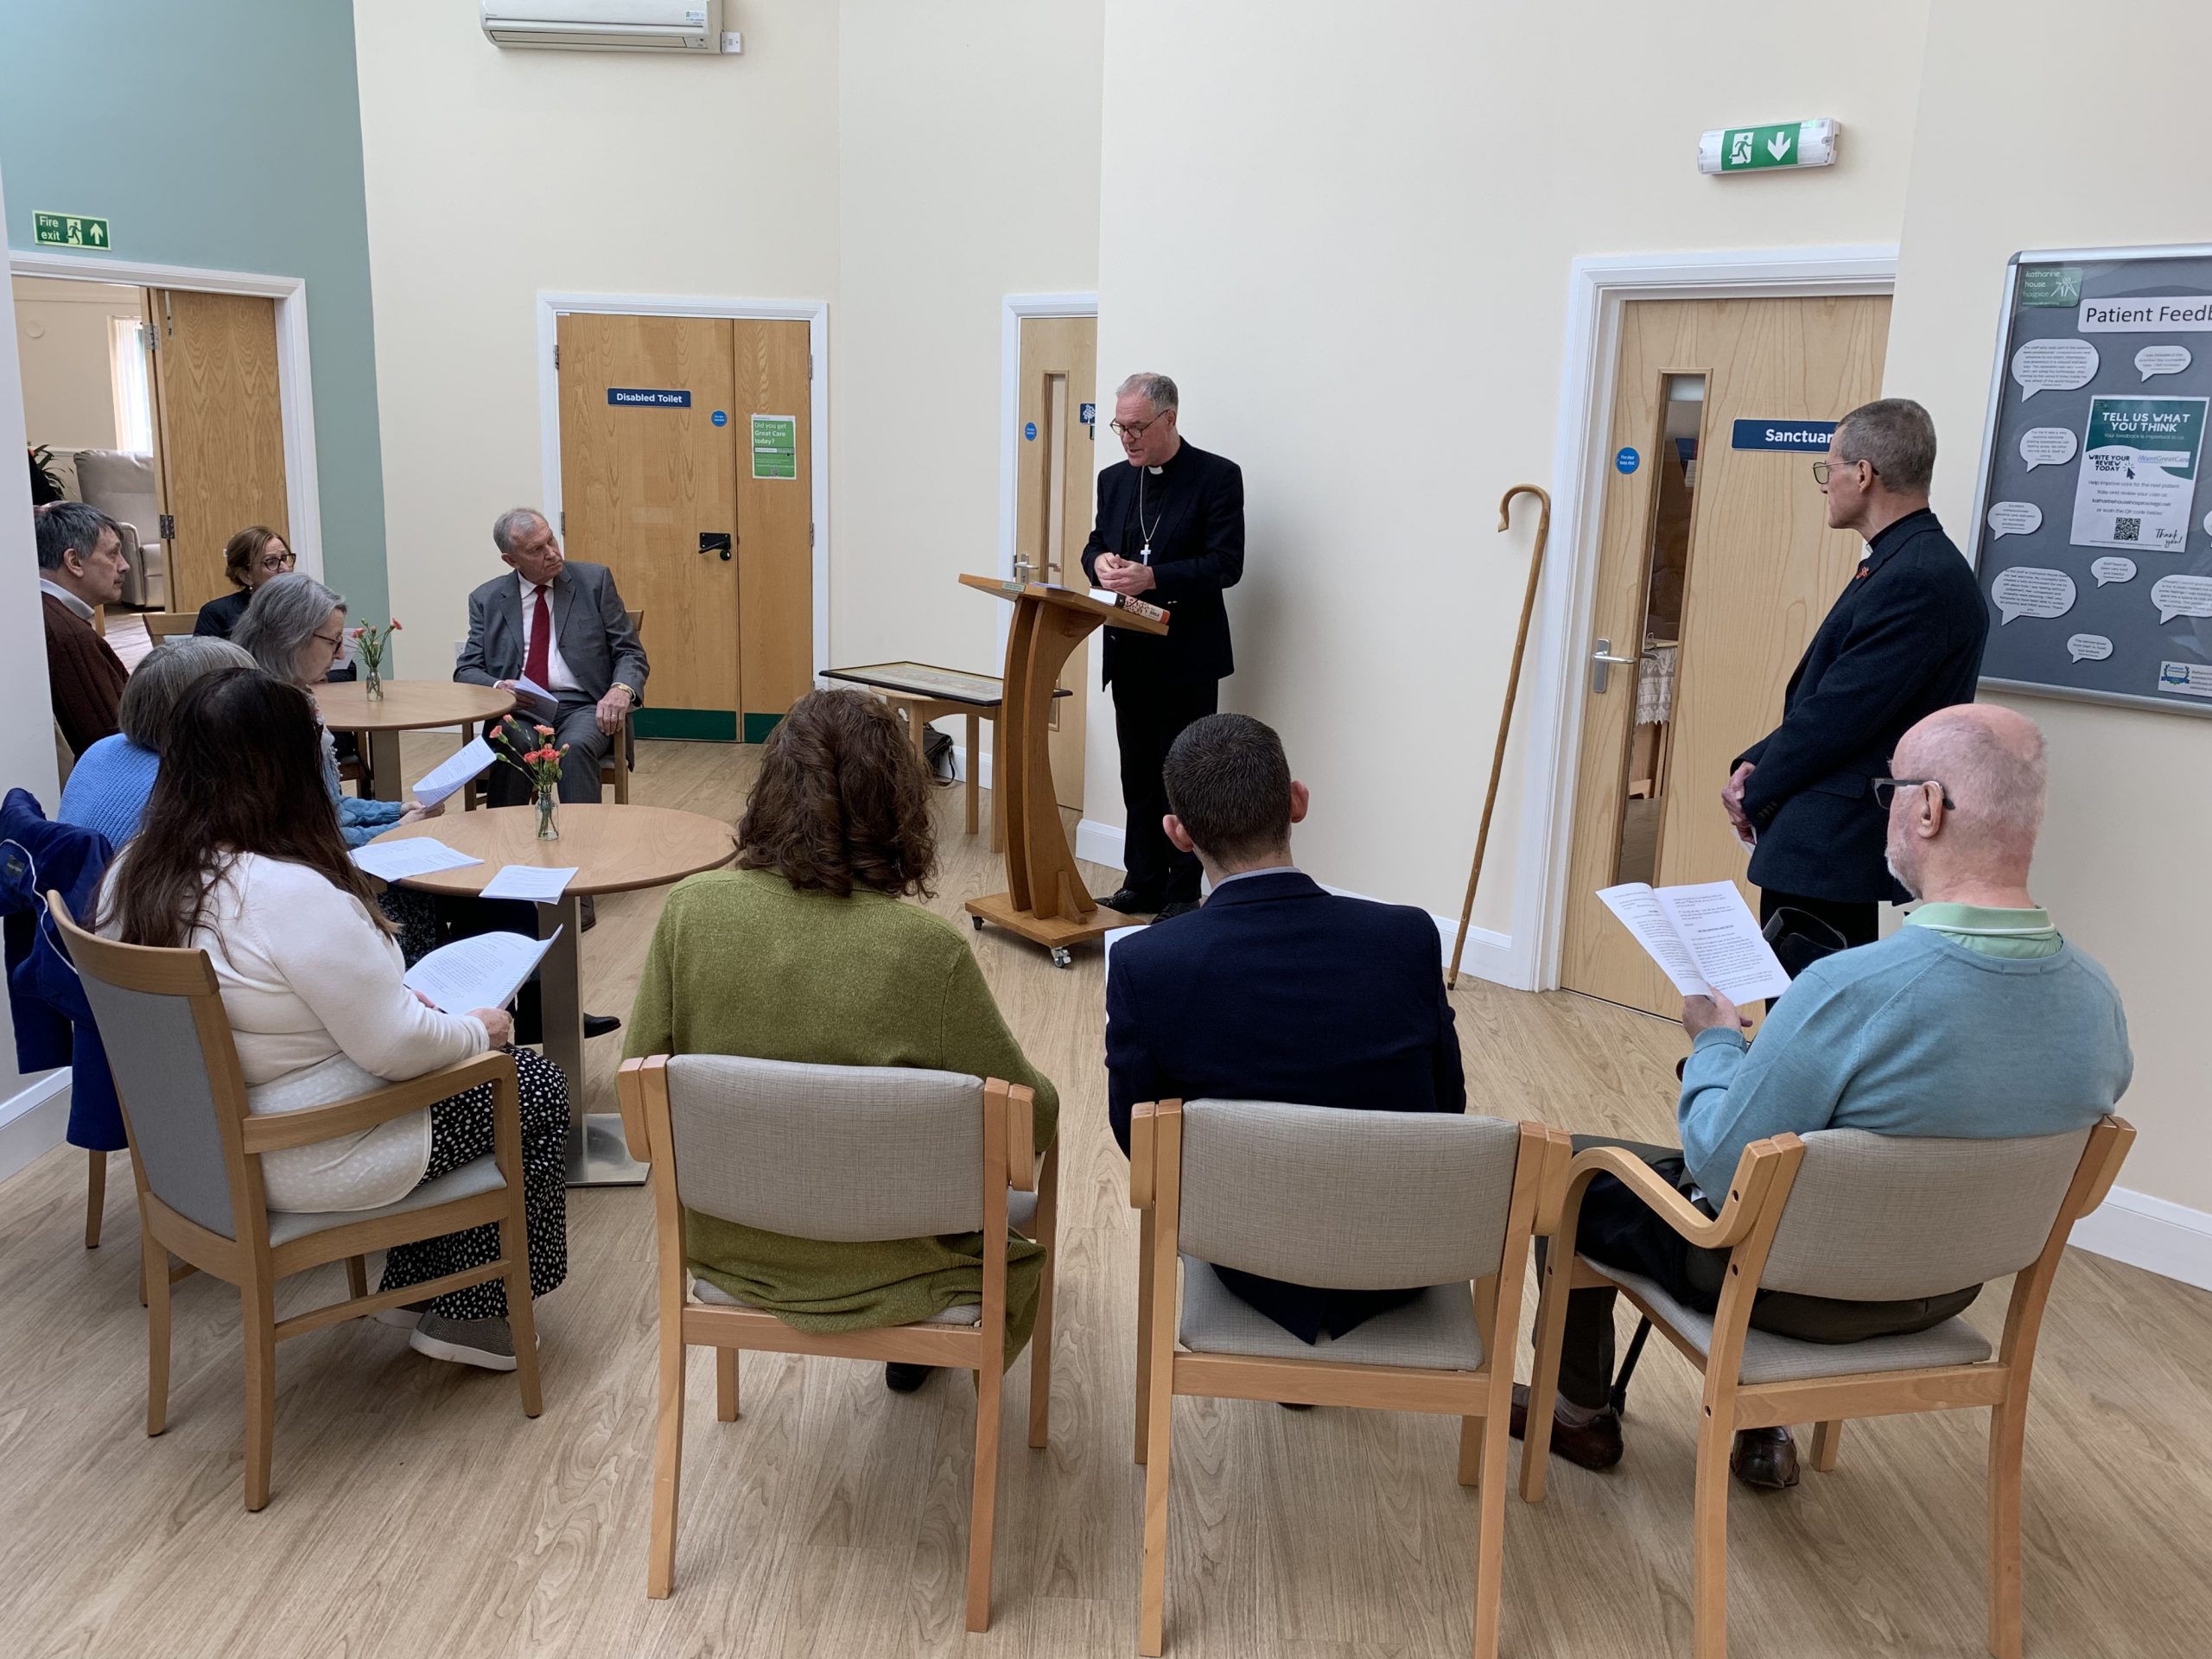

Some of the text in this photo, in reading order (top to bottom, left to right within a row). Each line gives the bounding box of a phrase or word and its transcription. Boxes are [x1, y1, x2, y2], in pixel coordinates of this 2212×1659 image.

[39, 215, 59, 227] Fire
[41, 230, 60, 240] exit
[2086, 307, 2153, 322] Patient
[616, 393, 683, 403] Disabled Toilet
[2101, 412, 2191, 423] TELL US WHAT
[2111, 422, 2178, 433] YOU THINK
[1765, 429, 1834, 443] Sanctuar
[2155, 528, 2178, 539] Thank
[2164, 536, 2183, 549] you!
